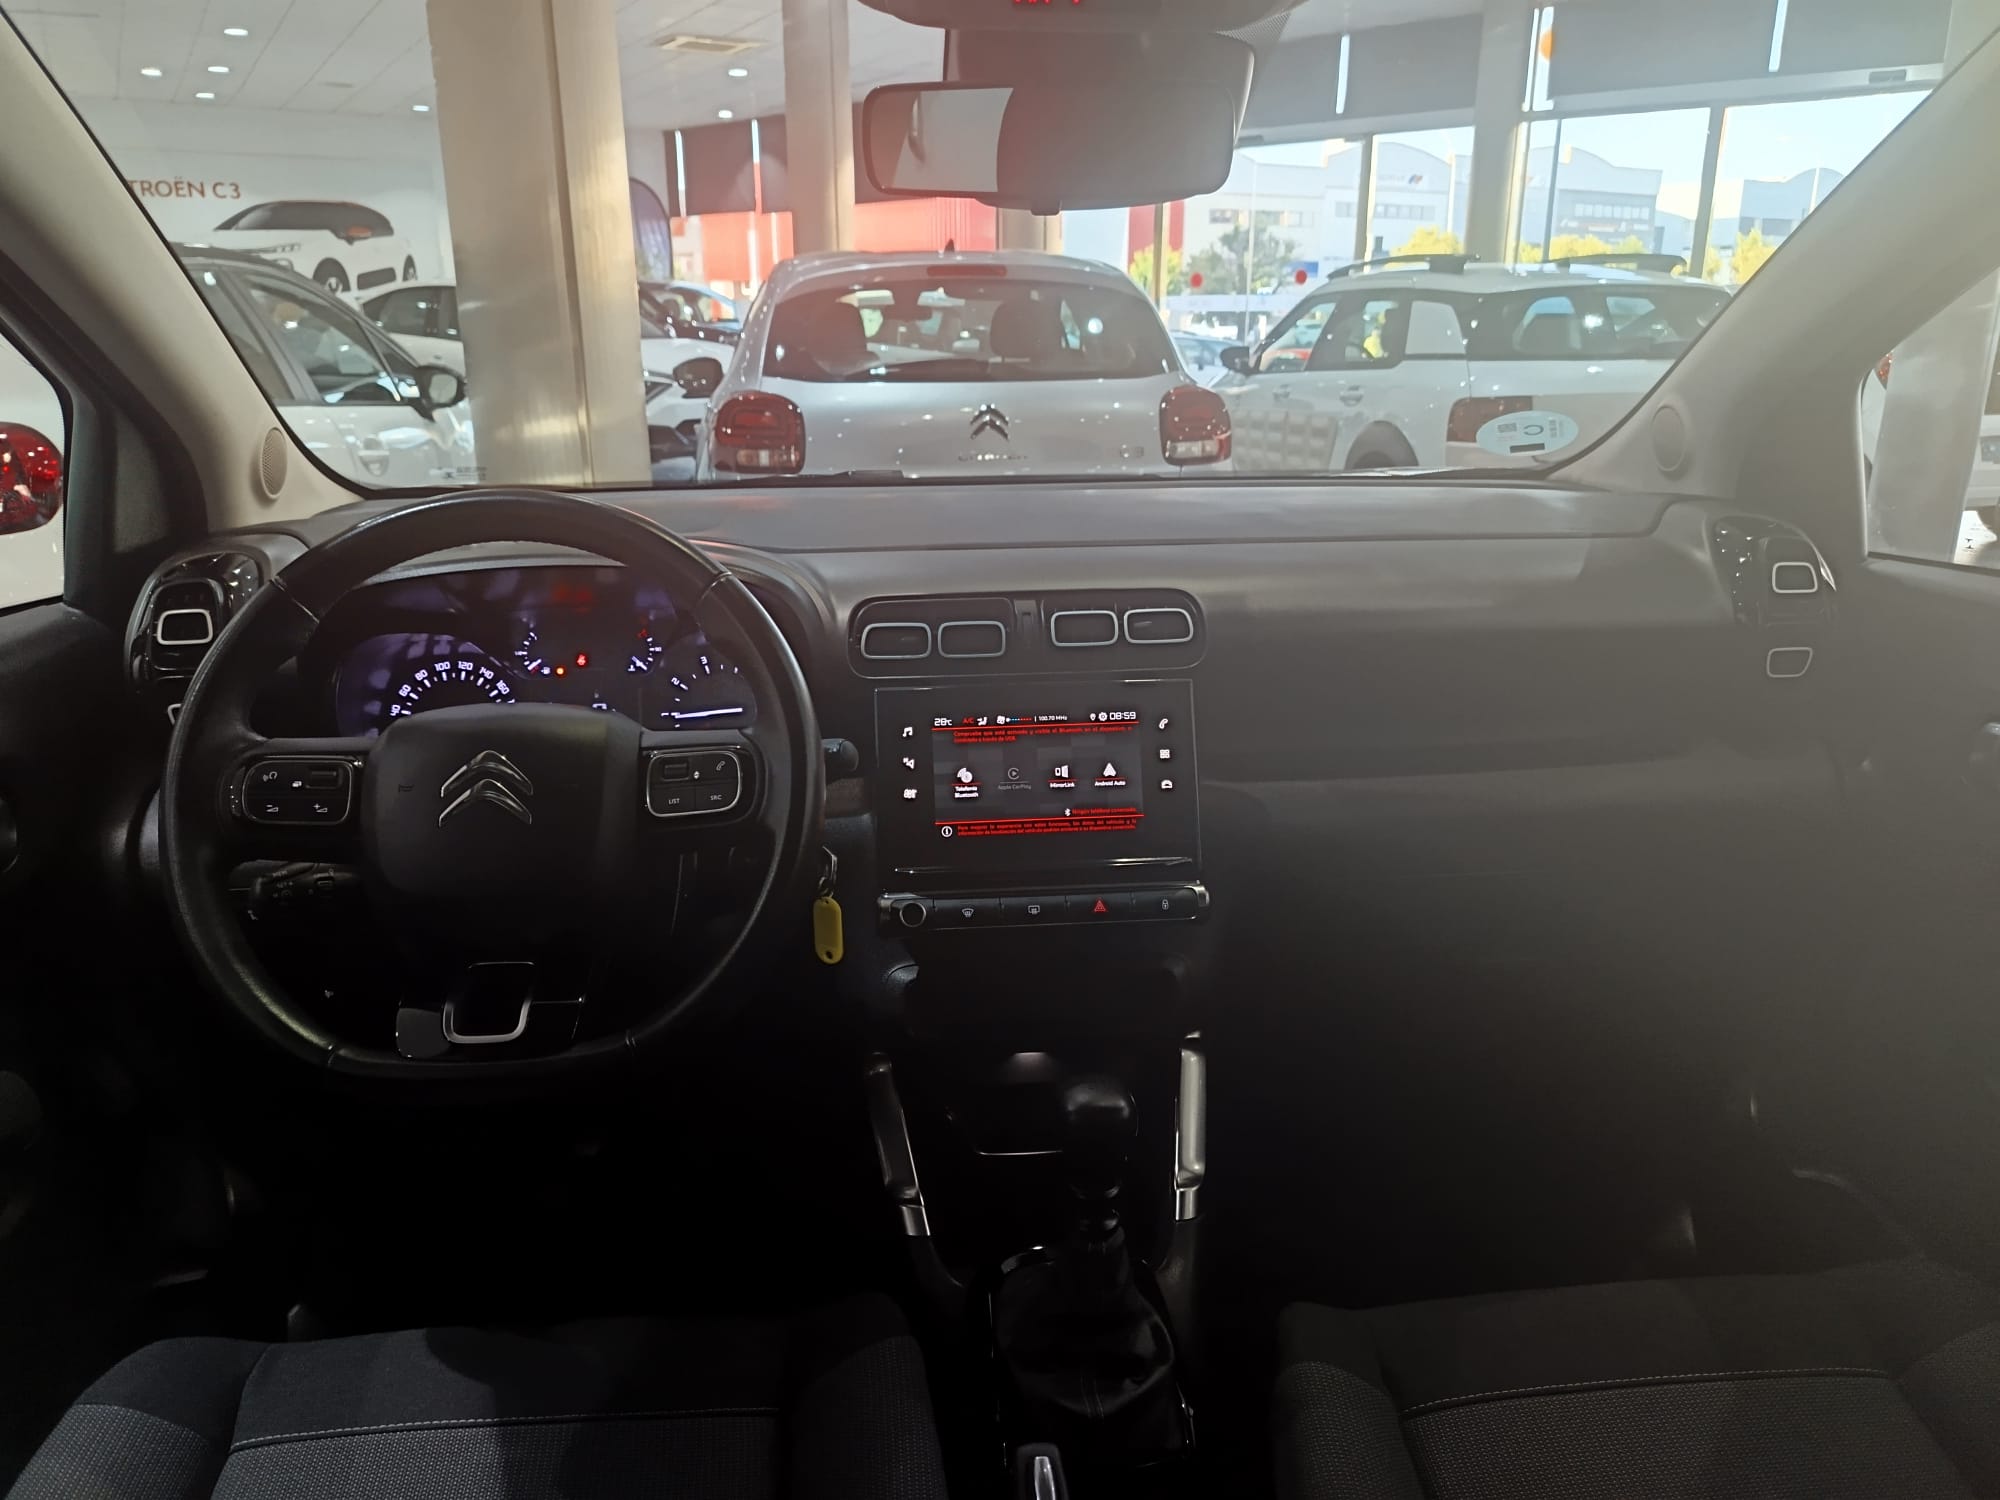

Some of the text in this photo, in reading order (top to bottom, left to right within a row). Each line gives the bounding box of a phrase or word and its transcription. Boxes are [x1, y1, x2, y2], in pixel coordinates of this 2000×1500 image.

[212, 182, 241, 199] C3
[434, 662, 451, 671] 100
[458, 660, 474, 670] 120
[414, 669, 428, 682] 80
[479, 666, 494, 680] 140
[398, 684, 412, 697] 60
[496, 680, 510, 695] 160
[1110, 712, 1136, 720] 08:59
